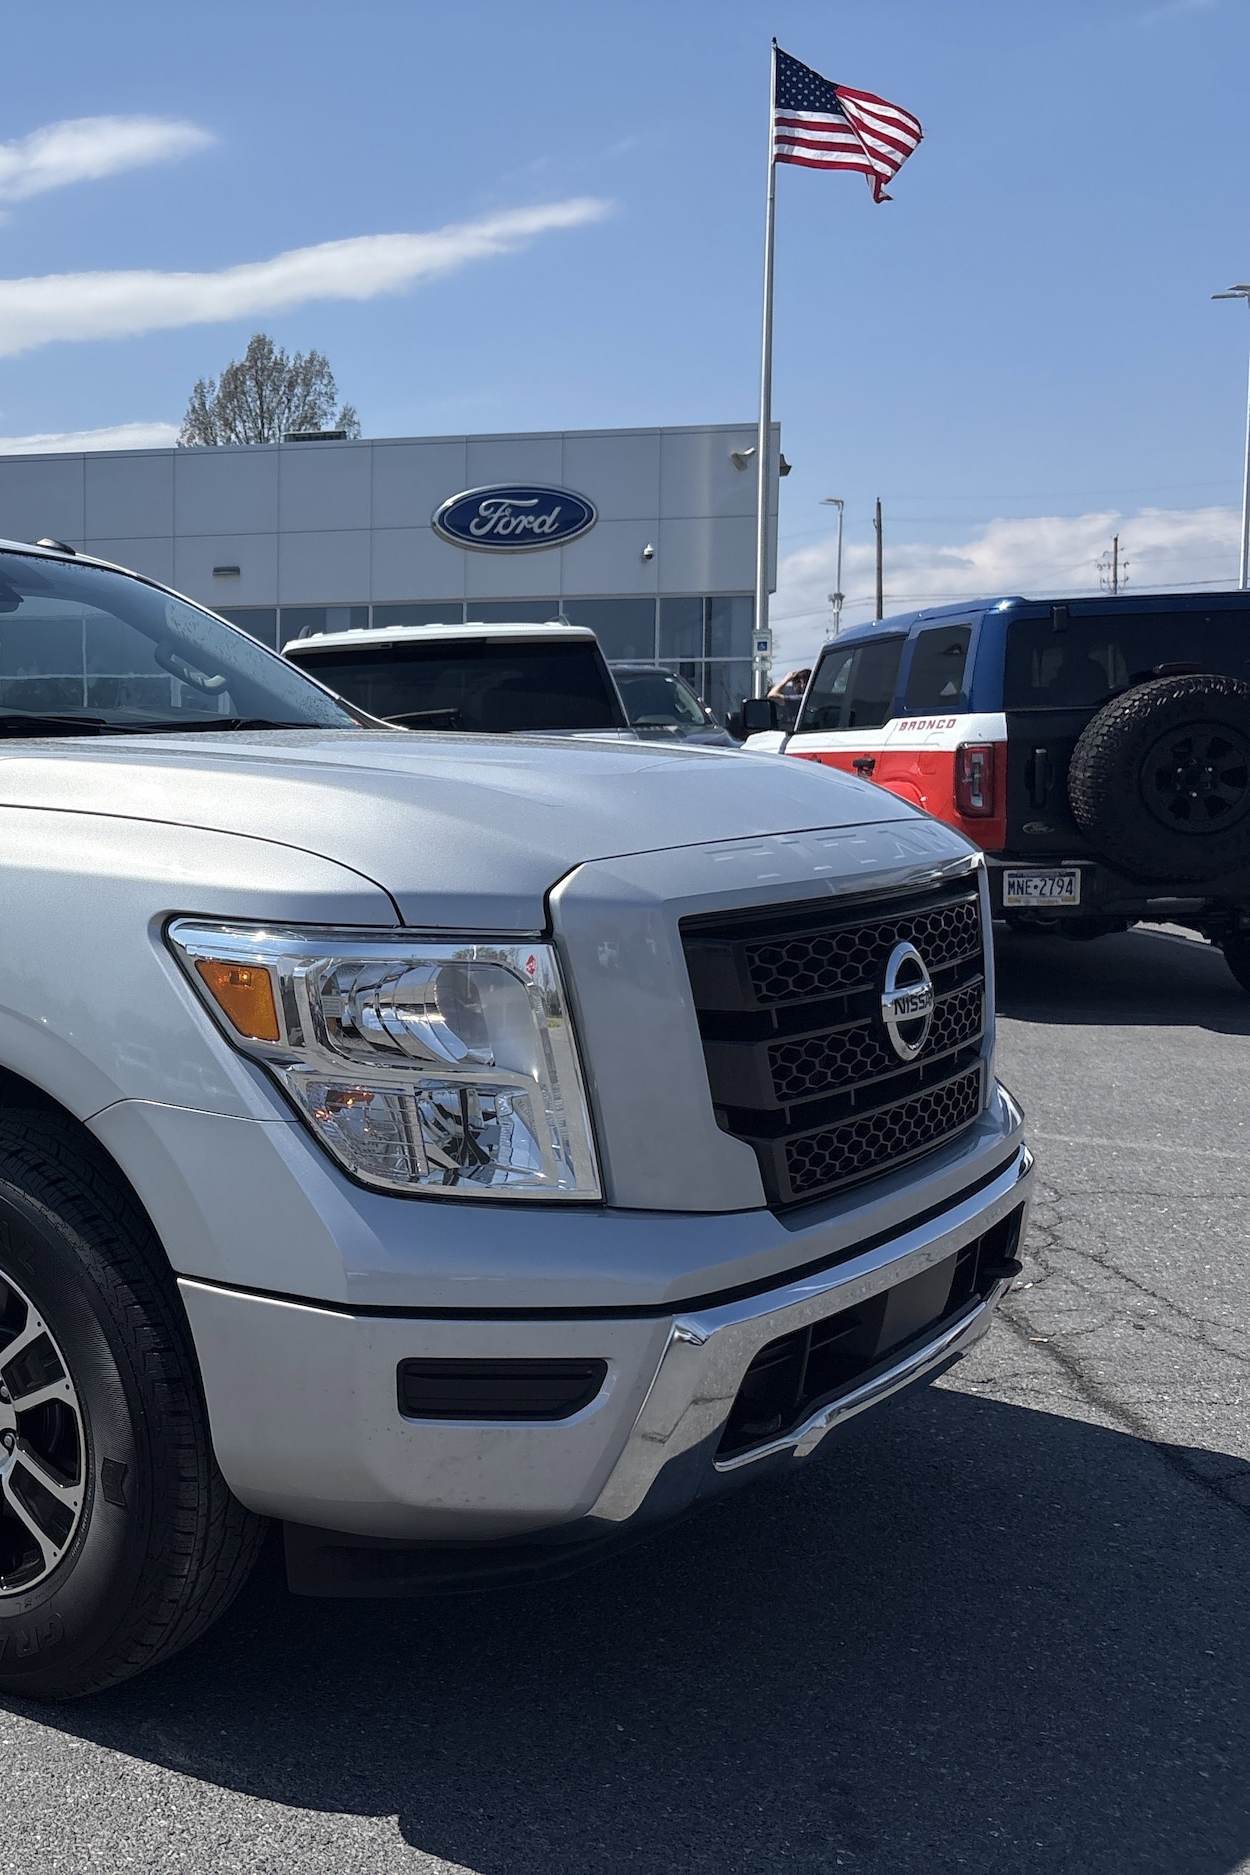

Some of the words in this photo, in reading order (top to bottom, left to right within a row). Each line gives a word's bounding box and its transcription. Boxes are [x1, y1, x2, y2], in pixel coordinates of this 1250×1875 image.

[469, 498, 561, 536] Ford
[898, 717, 958, 731] BRONCO
[894, 992, 933, 1016] NISSA
